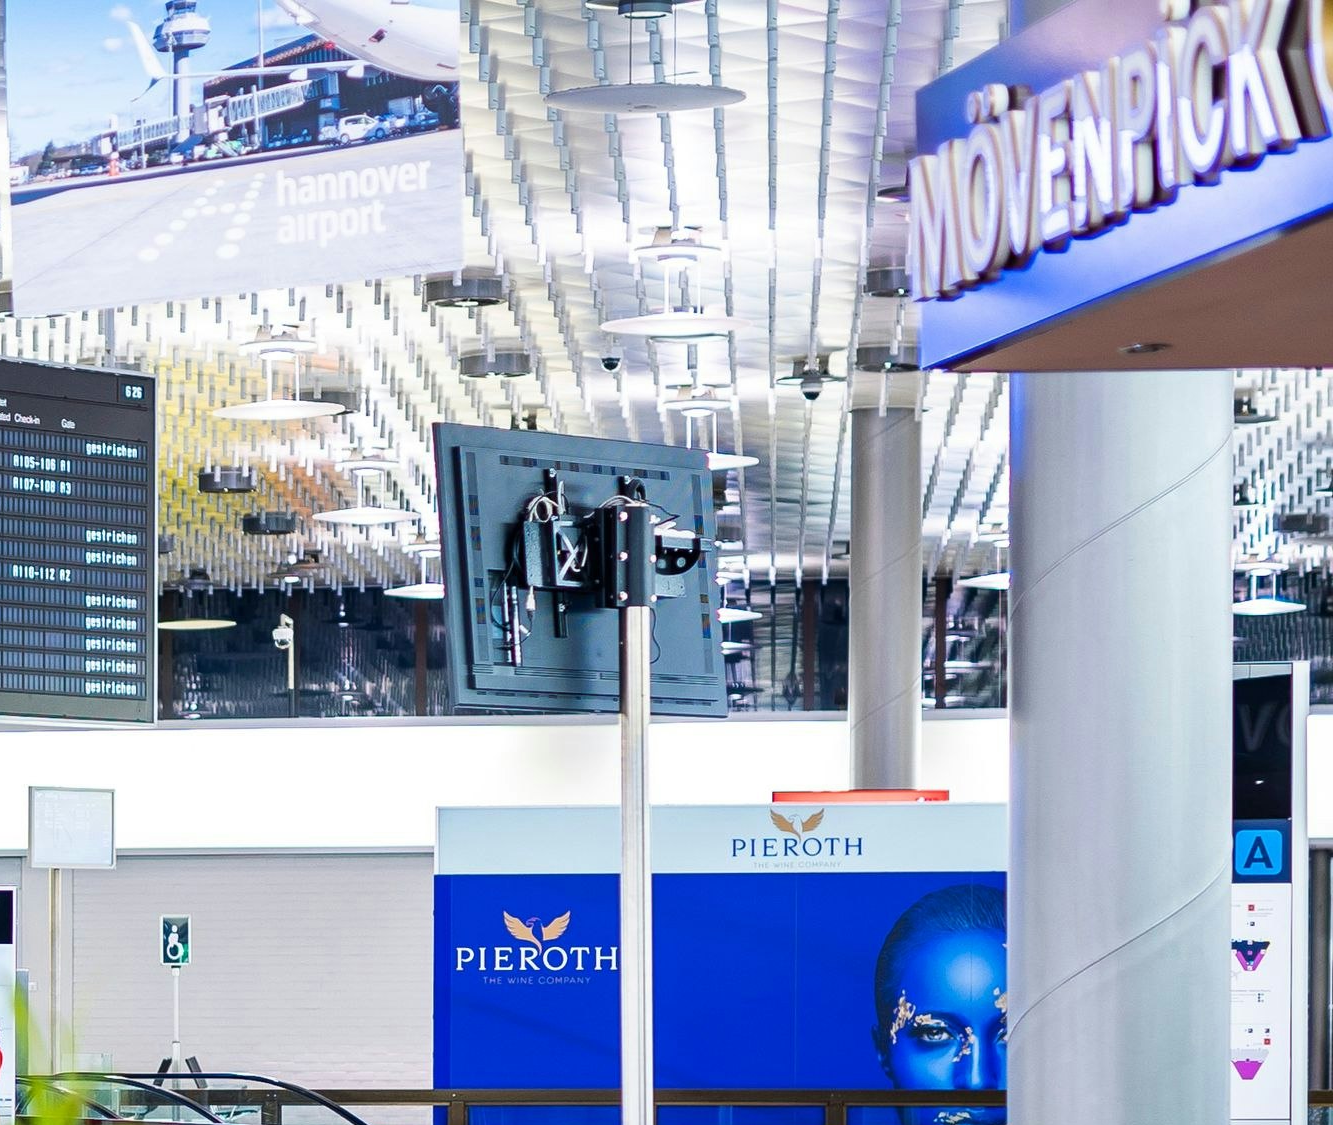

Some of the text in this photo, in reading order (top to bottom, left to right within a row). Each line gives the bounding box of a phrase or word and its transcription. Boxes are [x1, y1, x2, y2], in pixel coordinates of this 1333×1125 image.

[276, 160, 431, 206] hannover
[277, 200, 385, 247] airport
[86, 443, 137, 457] gestrichen
[86, 530, 137, 544] gestrichen
[732, 837, 863, 858] PIEROTH
[1244, 835, 1274, 869] A
[798, 861, 842, 869] COMPANY
[455, 945, 619, 972] PIEROTH
[483, 976, 592, 985] THE WINE COMPANY
